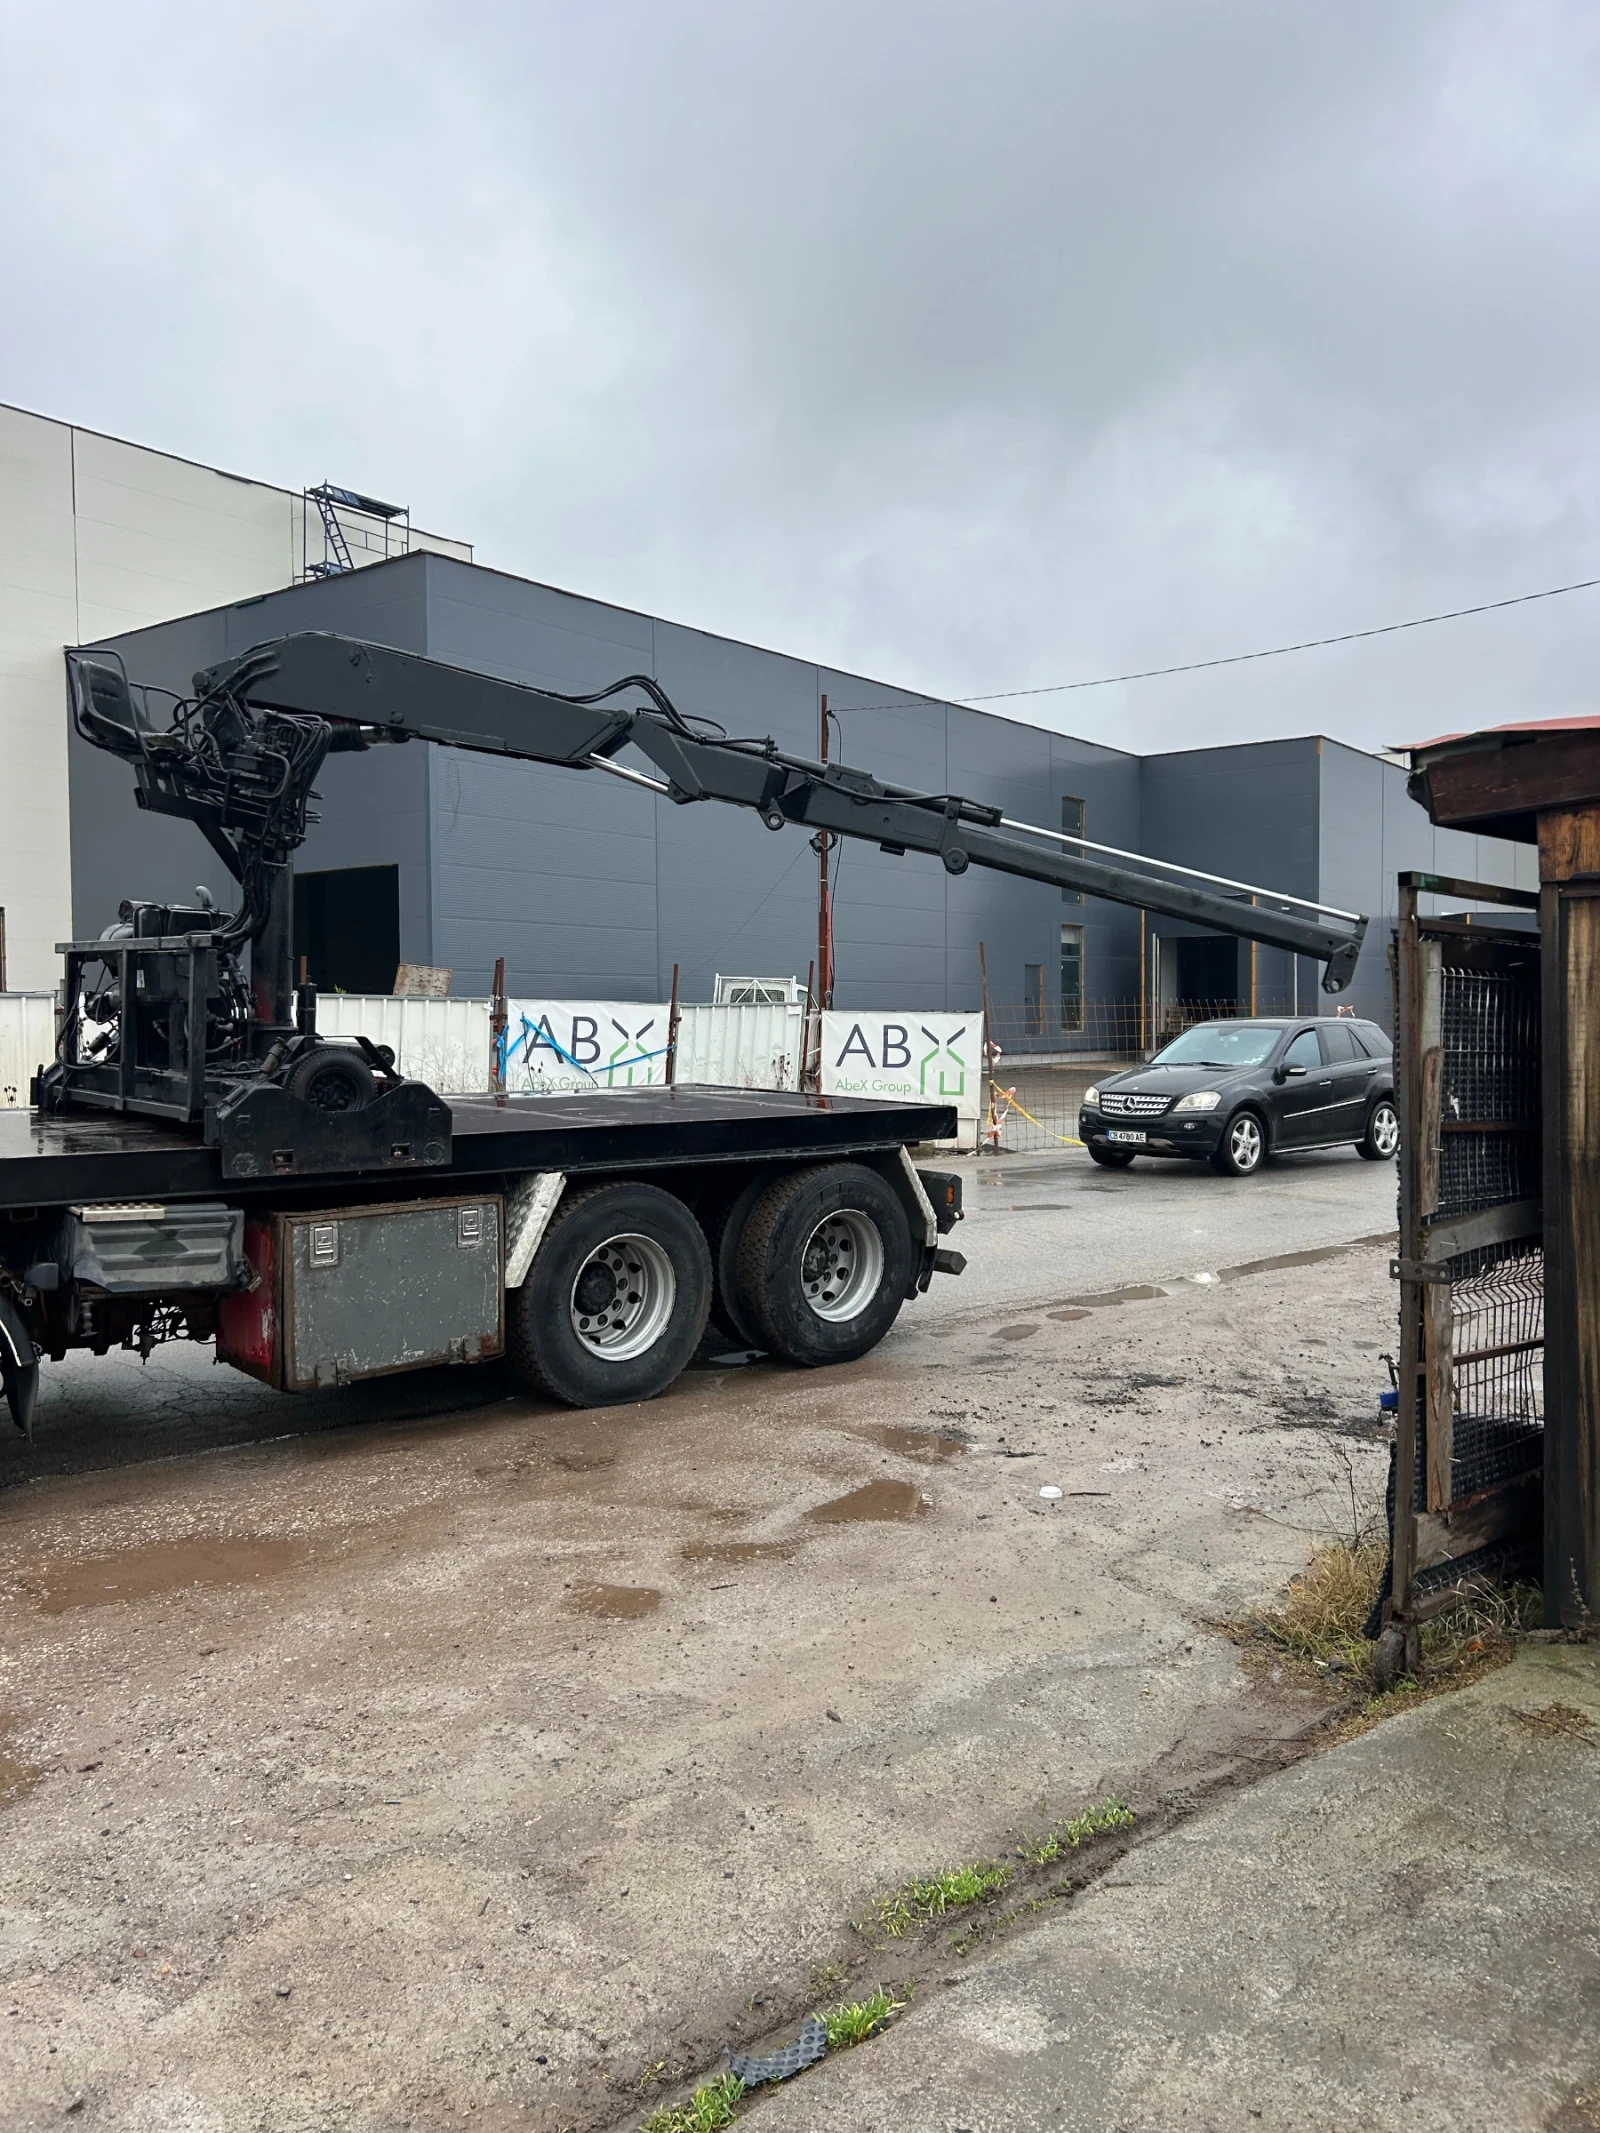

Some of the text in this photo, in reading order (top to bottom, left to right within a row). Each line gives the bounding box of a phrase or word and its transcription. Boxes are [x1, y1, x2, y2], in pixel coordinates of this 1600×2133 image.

[834, 1078, 912, 1096] AbeX Group
[1136, 1133, 1145, 1142] AE
